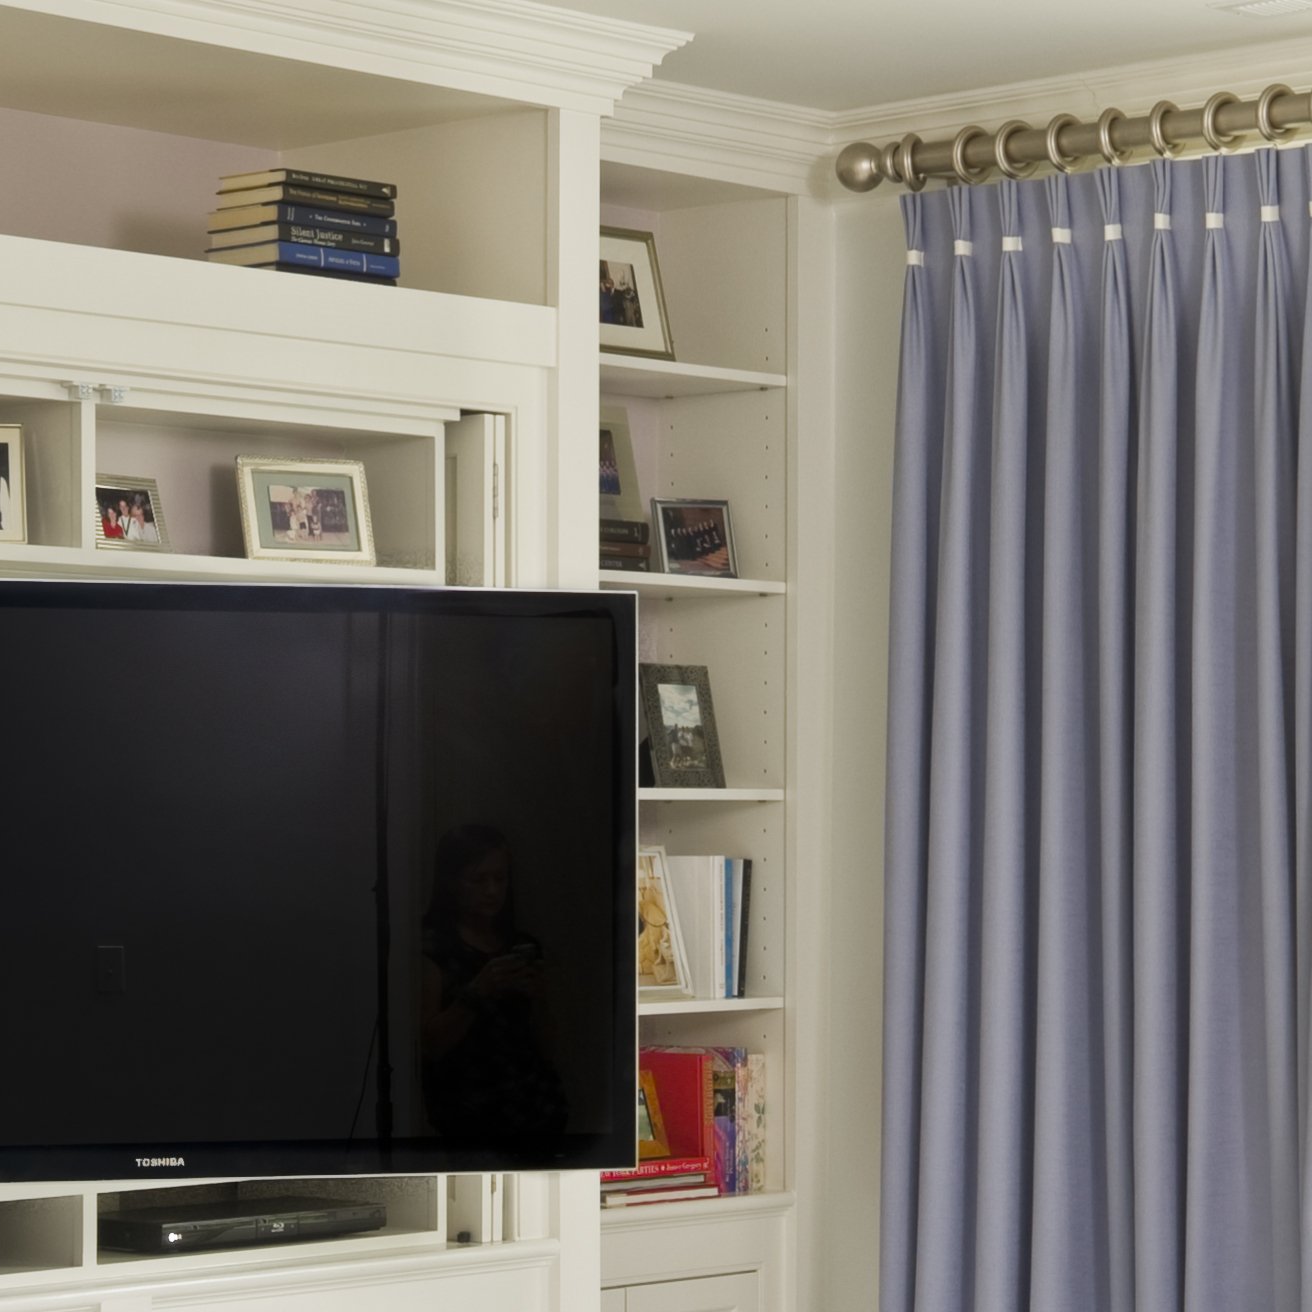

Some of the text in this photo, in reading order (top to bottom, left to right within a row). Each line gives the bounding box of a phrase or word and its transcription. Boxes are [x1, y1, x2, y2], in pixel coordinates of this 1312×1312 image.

[290, 226, 343, 242] Silent Justice
[135, 1157, 185, 1168] TOSHIBA
